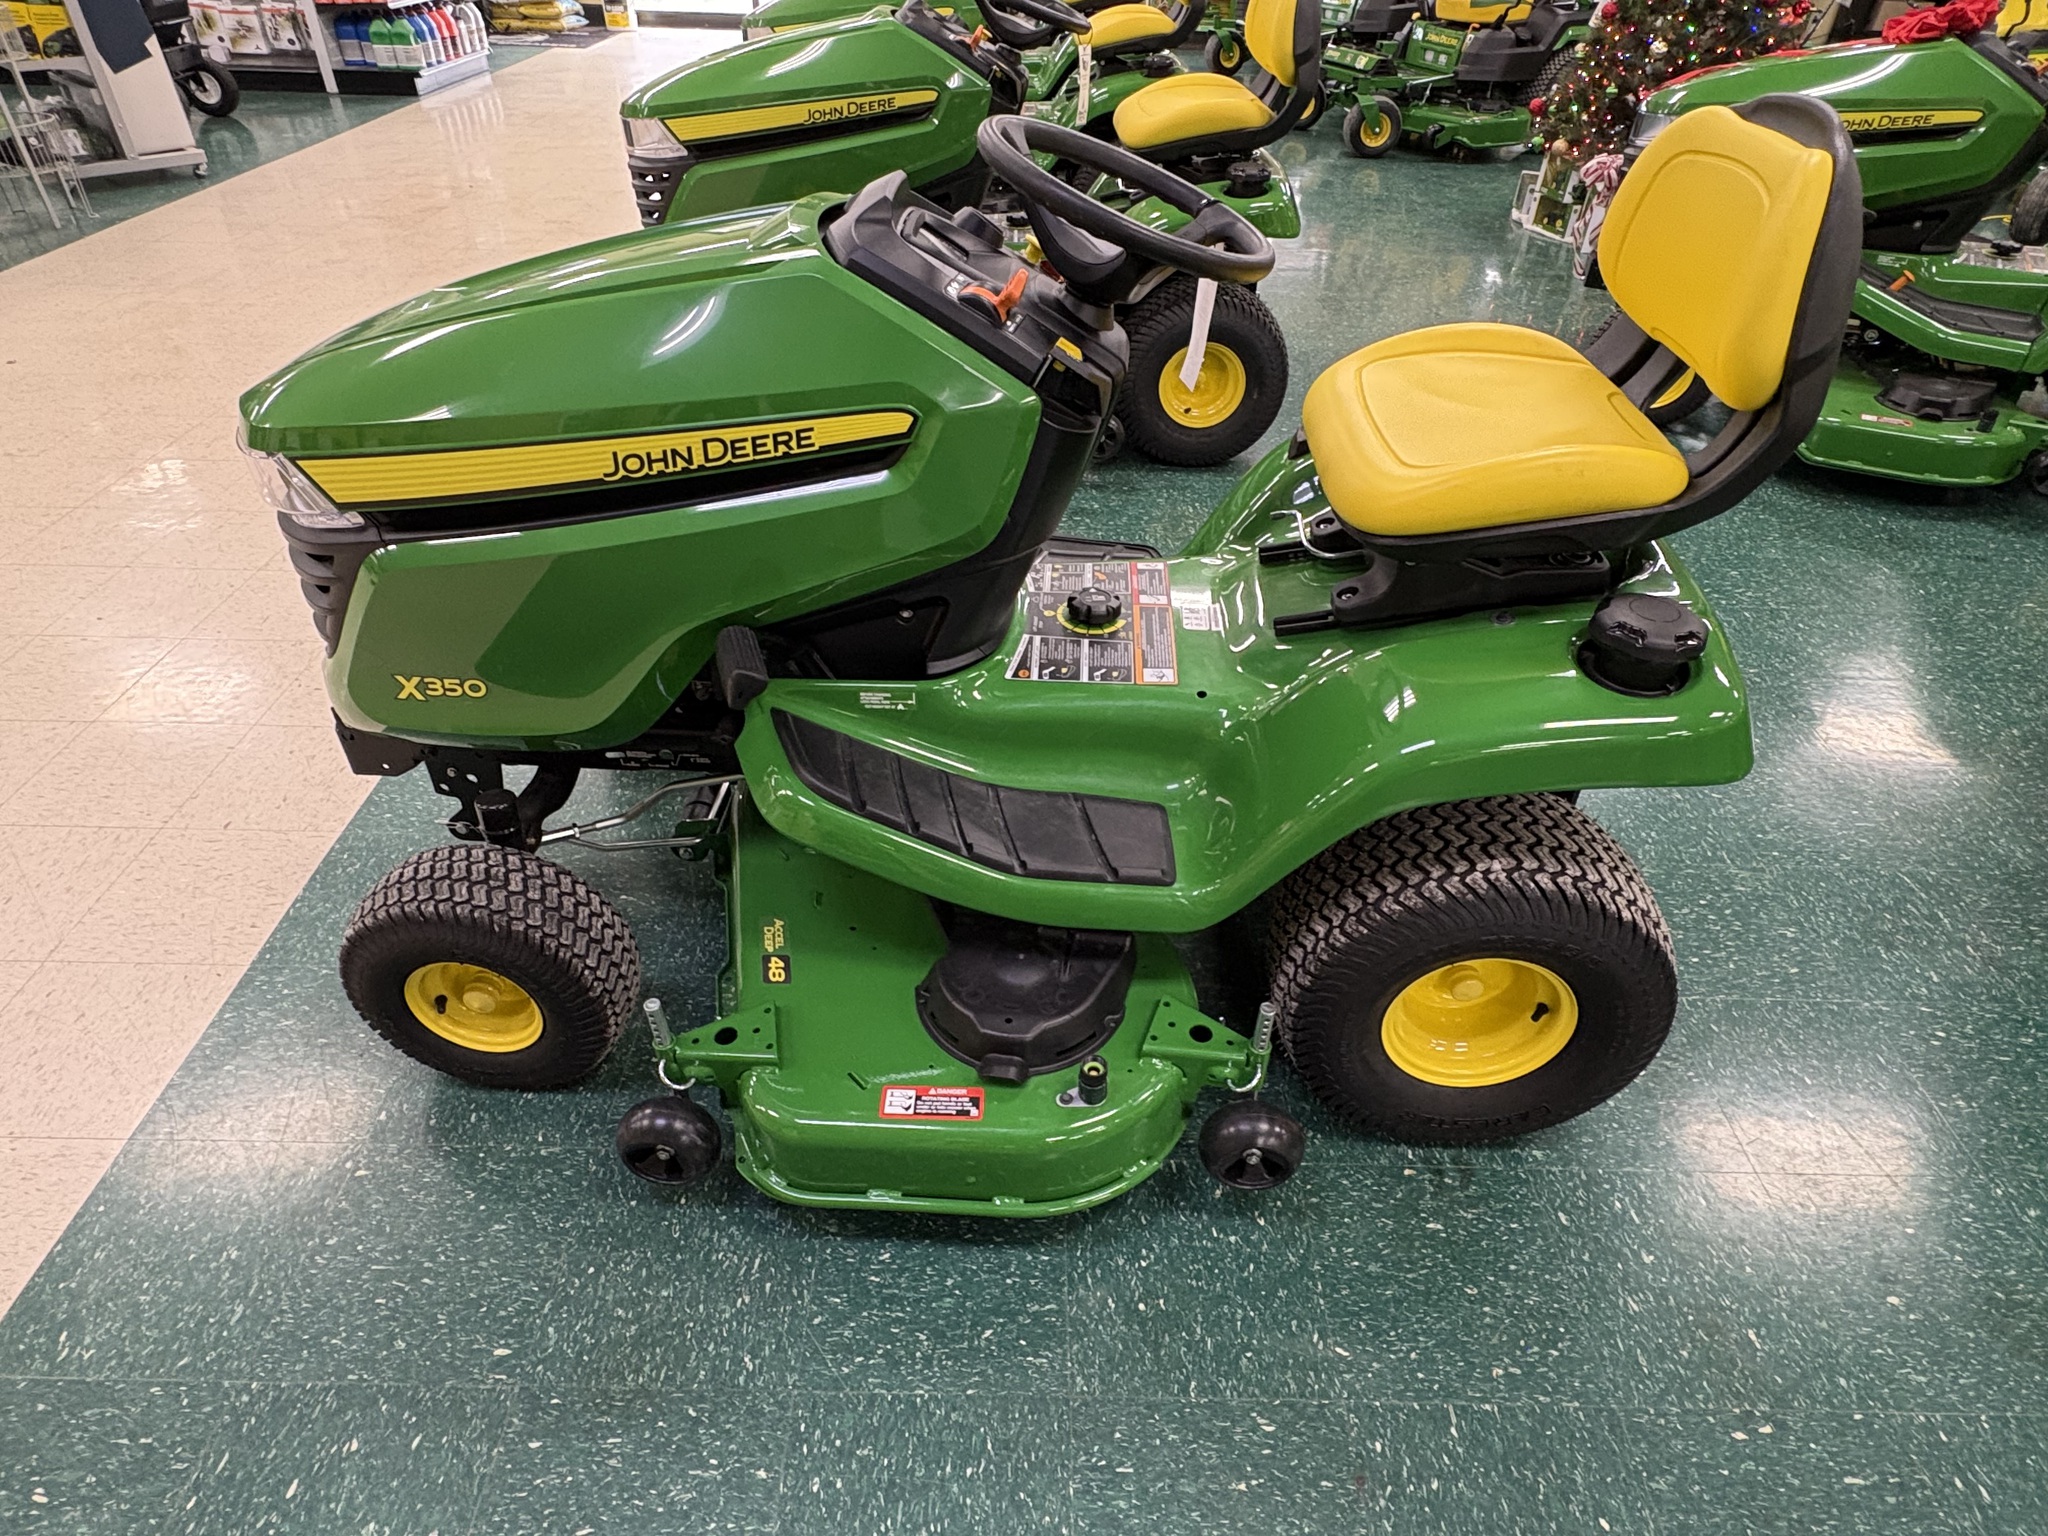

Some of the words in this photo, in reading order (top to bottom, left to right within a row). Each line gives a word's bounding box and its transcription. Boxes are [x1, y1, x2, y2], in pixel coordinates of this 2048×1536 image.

[803, 106, 844, 123] JOHN
[847, 97, 896, 116] DEERE
[1842, 117, 1874, 130] OHN
[1878, 114, 1935, 128] DEERE
[602, 445, 694, 478] JOHN
[702, 427, 816, 464] DEERE
[391, 674, 488, 701] X350
[763, 926, 775, 953] DEEP
[773, 918, 785, 950] ACCEL
[767, 956, 786, 983] 48
